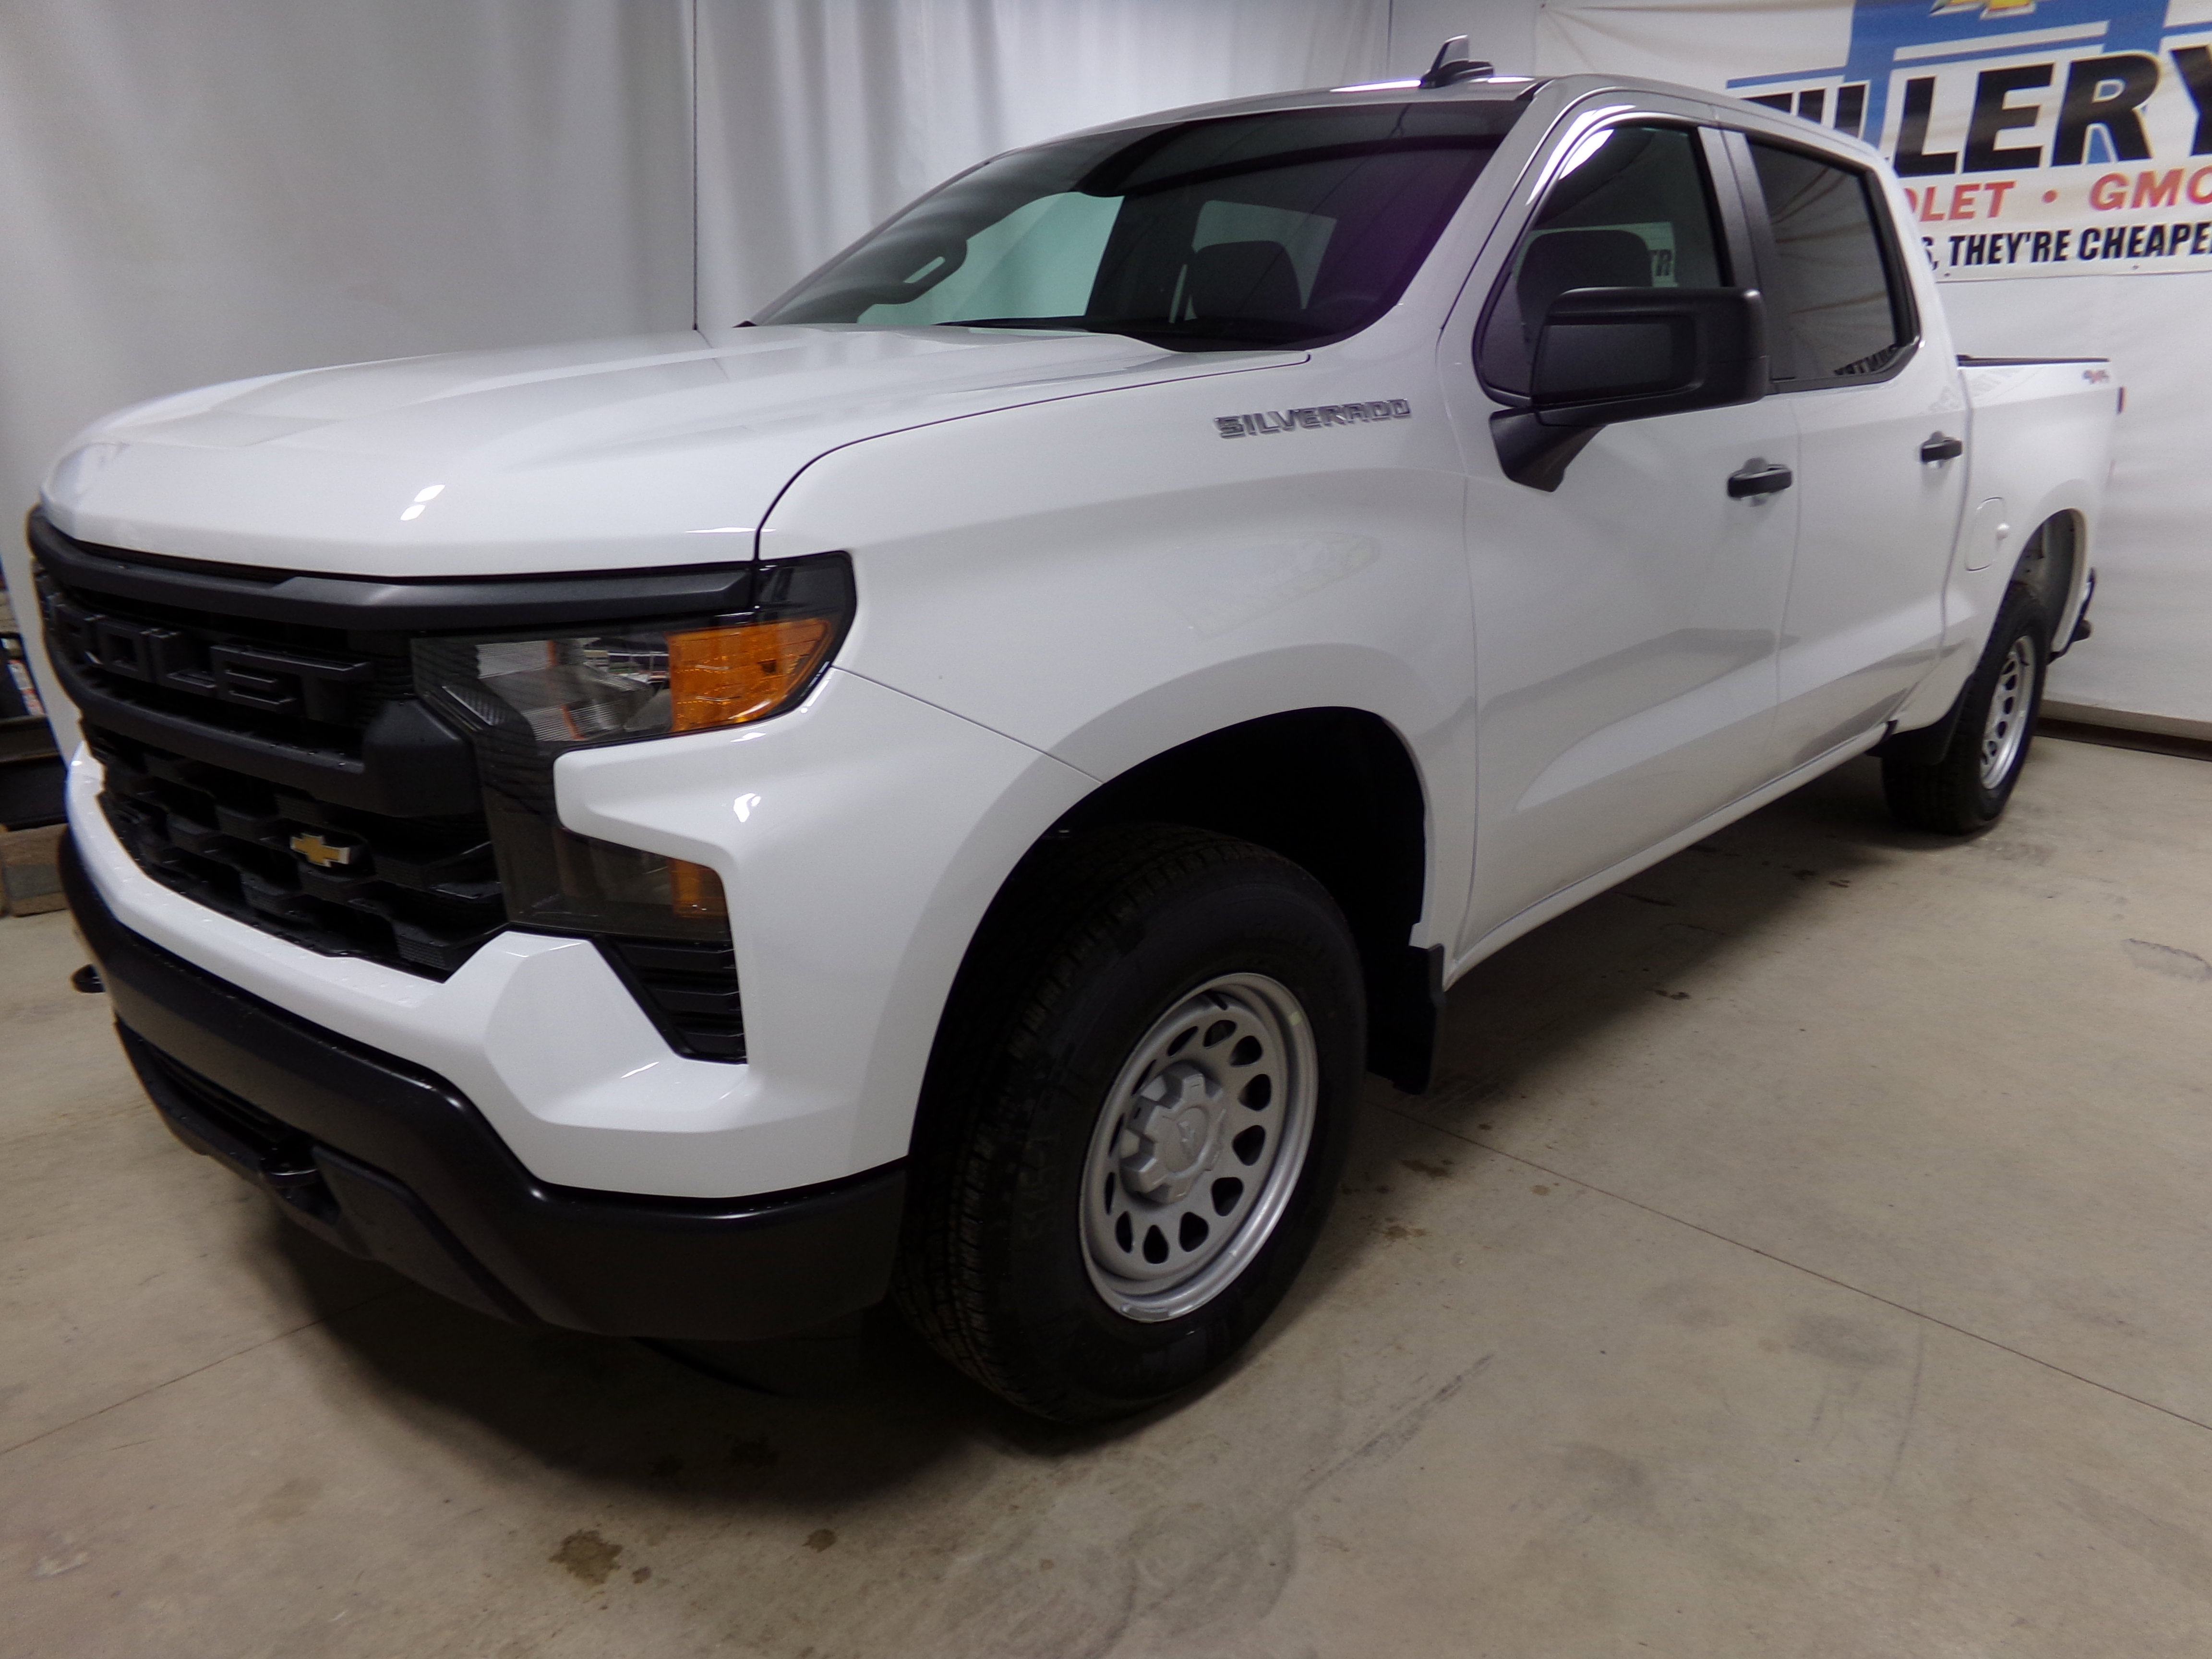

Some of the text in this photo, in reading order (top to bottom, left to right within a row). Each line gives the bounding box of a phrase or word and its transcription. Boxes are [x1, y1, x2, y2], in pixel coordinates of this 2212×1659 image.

[1948, 228, 2072, 266] THEY'RE
[2078, 222, 2212, 261] CHEAPE
[1214, 398, 1412, 439] SILVERADO
